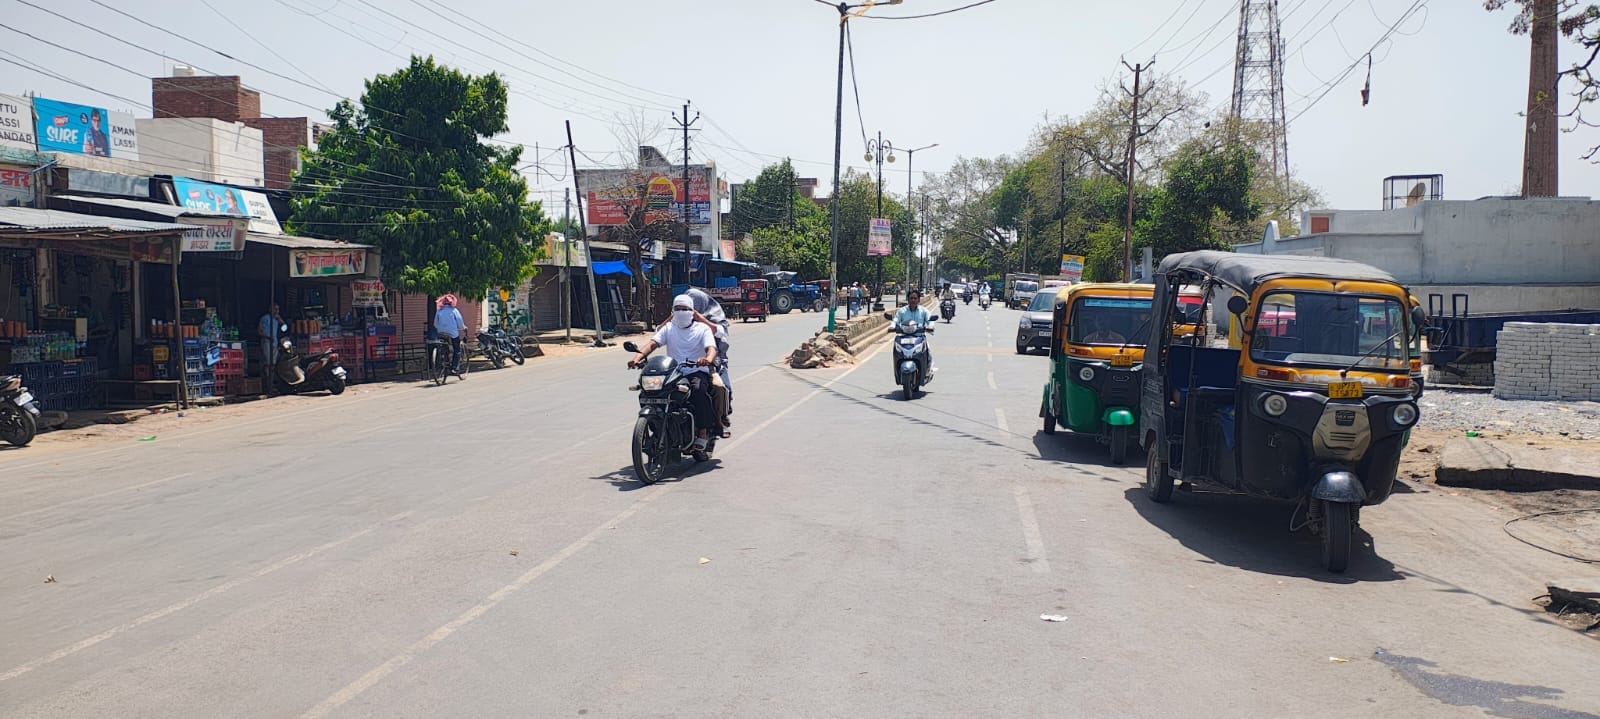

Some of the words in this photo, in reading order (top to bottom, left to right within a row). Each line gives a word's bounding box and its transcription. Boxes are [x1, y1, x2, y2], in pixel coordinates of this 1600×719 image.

[46, 125, 79, 144] SURE
[112, 125, 135, 136] AMAN
[114, 138, 135, 148] LASSI
